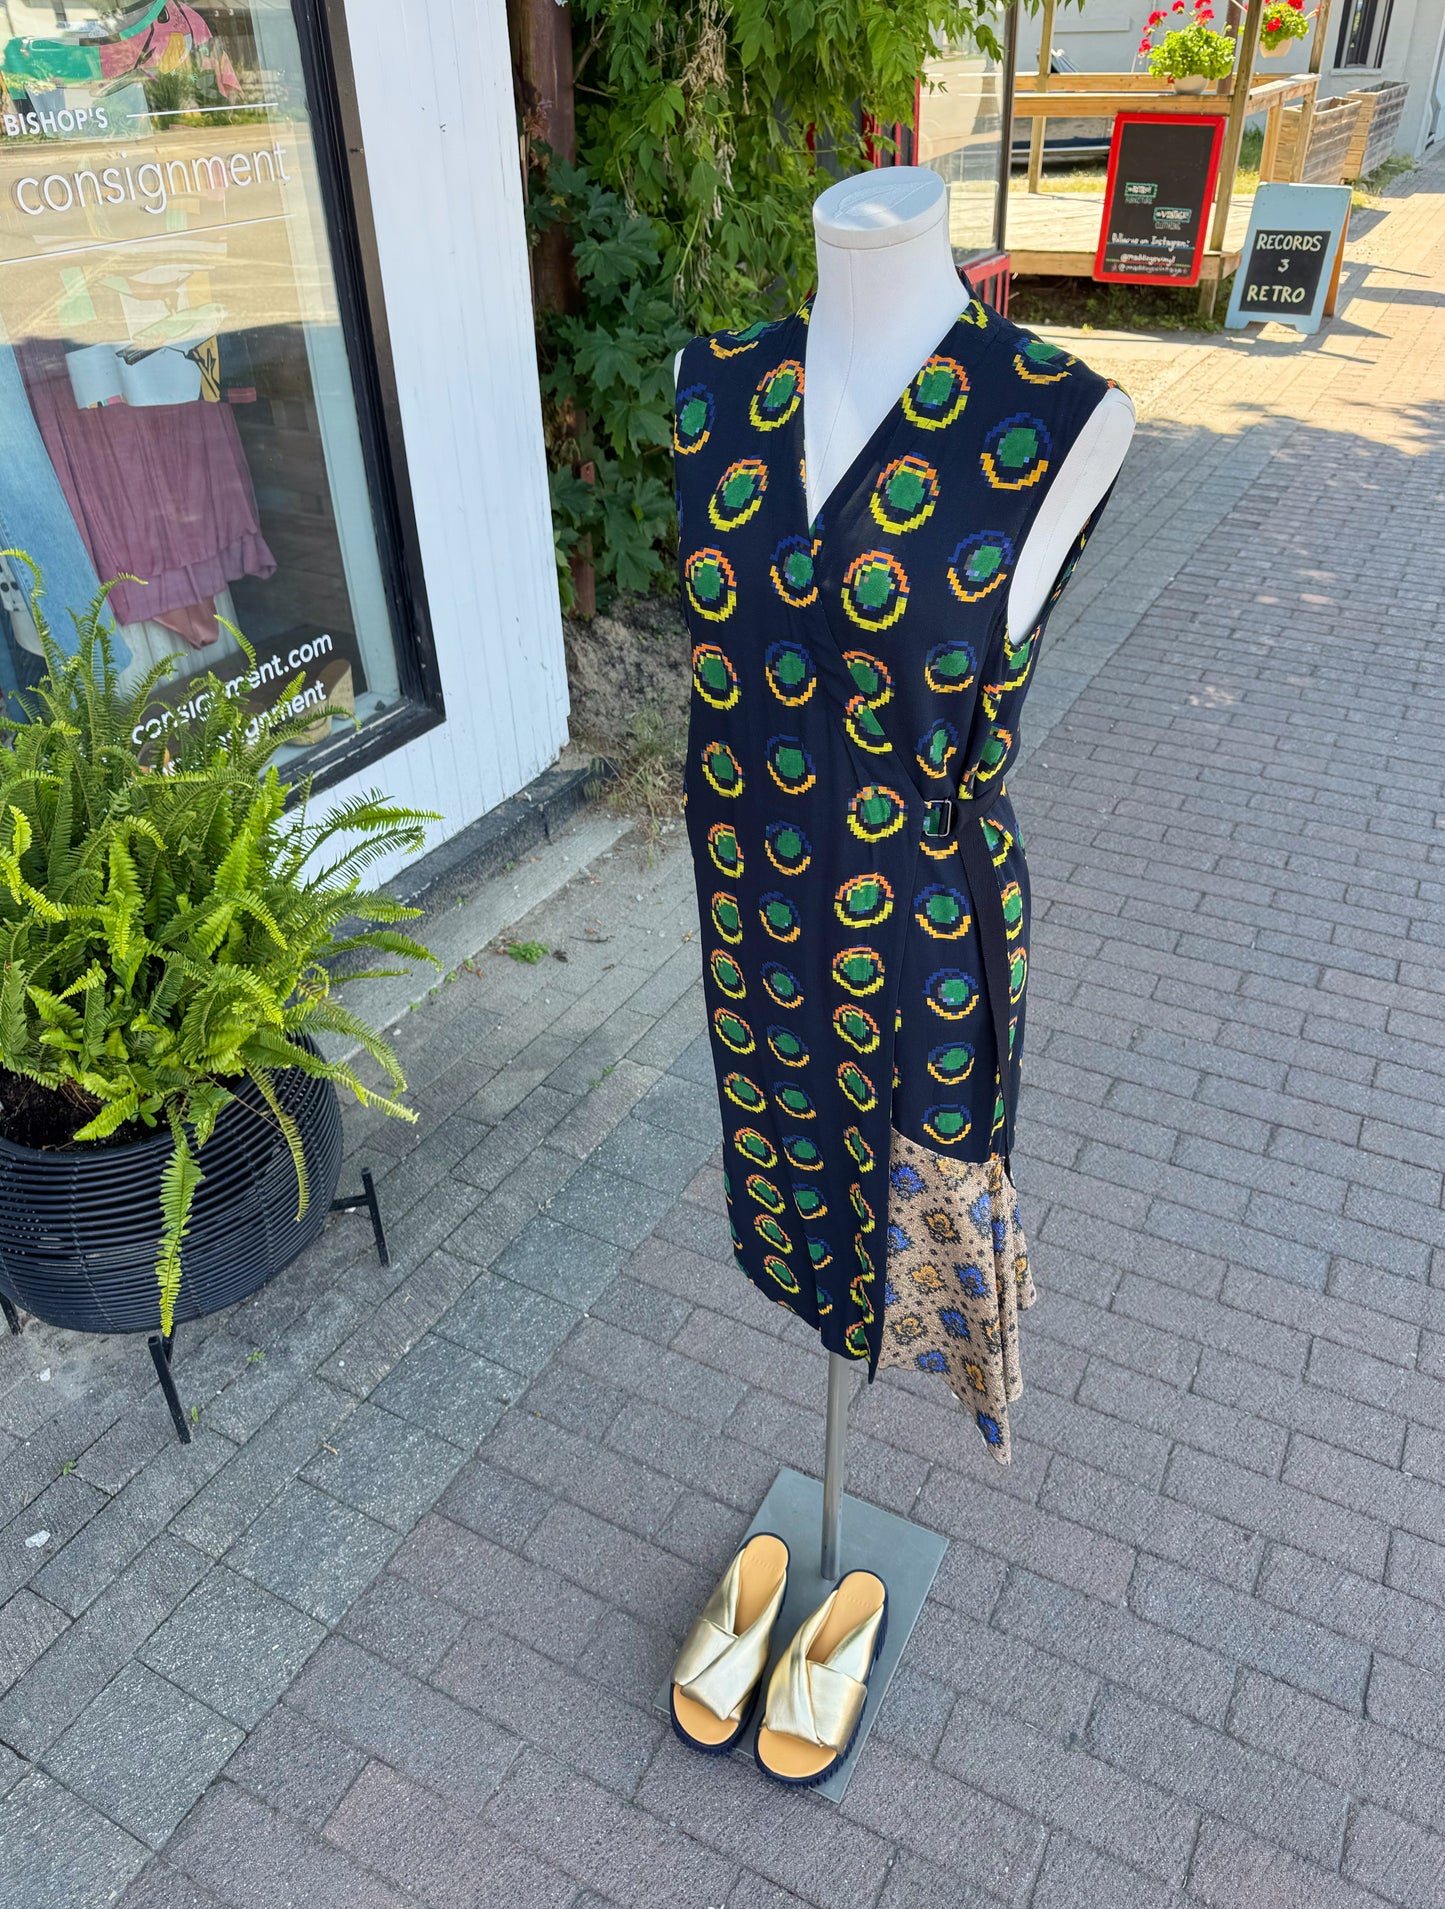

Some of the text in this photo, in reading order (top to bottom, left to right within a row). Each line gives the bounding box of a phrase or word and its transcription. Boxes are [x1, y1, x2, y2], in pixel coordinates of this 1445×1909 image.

[3, 107, 109, 136] BISHOP'S
[15, 141, 290, 215] consignment
[1256, 233, 1323, 252] RECORDS
[1246, 284, 1306, 303] RETRO
